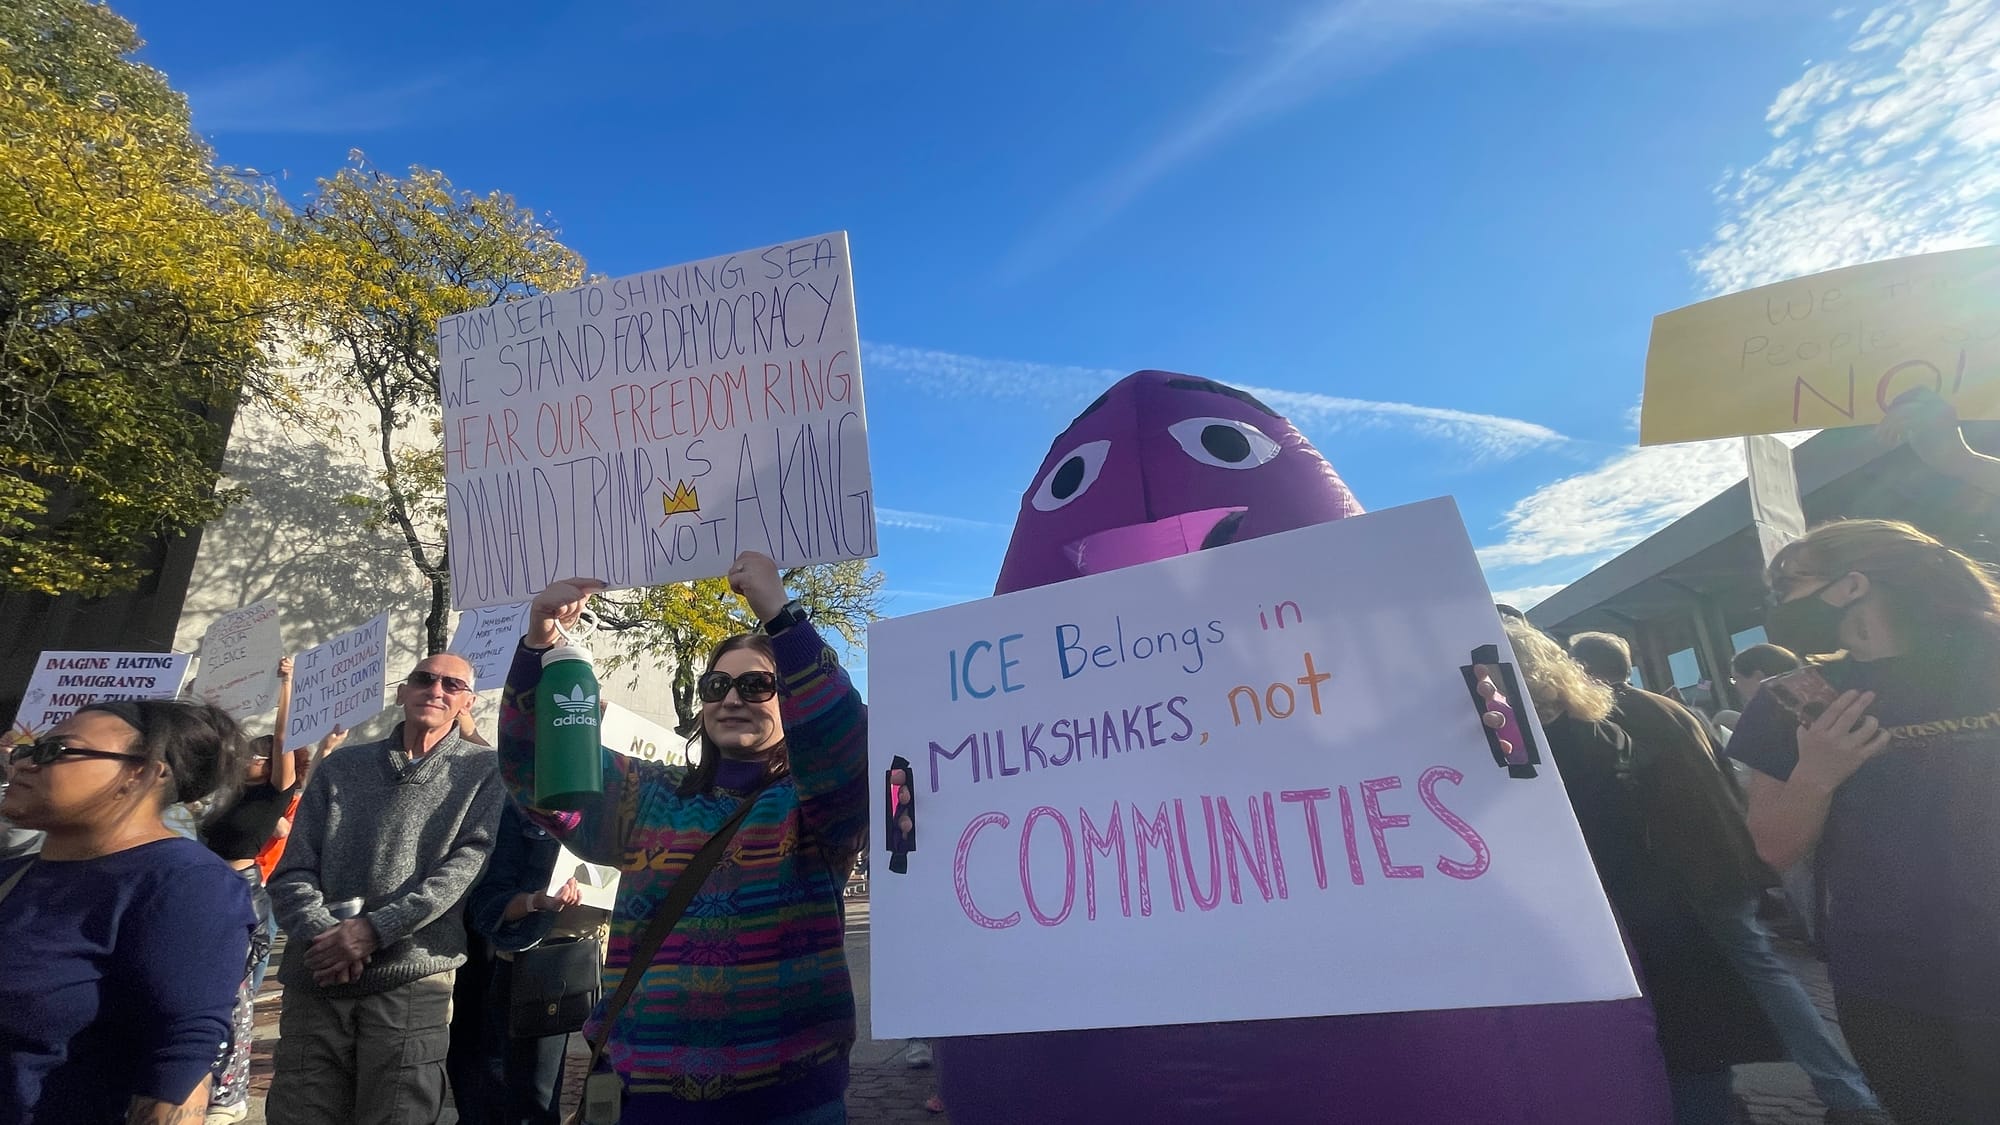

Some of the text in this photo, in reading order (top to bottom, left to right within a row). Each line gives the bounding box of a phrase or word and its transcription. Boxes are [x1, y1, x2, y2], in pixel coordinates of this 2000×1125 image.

[439, 239, 837, 357] FROM SEA TO SHINING SEA
[1766, 287, 1844, 327] We
[441, 274, 840, 409] WE STAND FOR DEMOCRACY
[1741, 319, 1896, 370] People
[444, 350, 852, 474] HEAR OUR FREEDOM RING
[446, 411, 873, 607] DONALD TRUMP IS NOT A KING
[46, 656, 173, 671] IMAGINE HATING
[294, 668, 326, 694] WANT
[331, 641, 380, 678] CRIMINALS
[305, 649, 322, 670] IF
[330, 638, 350, 657] YOU
[948, 599, 1303, 702] ICE Belongs in
[48, 693, 98, 707] MORE
[57, 675, 156, 689] IMMIGRANTS
[291, 681, 380, 737] DON'T ELECT ONE
[295, 658, 382, 713] IN THIS COUNTRY
[552, 713, 598, 727] adidas
[928, 651, 1331, 793] MILKSHAKES, not
[630, 735, 657, 760] NO
[952, 764, 1491, 930] COMMUNITIES
